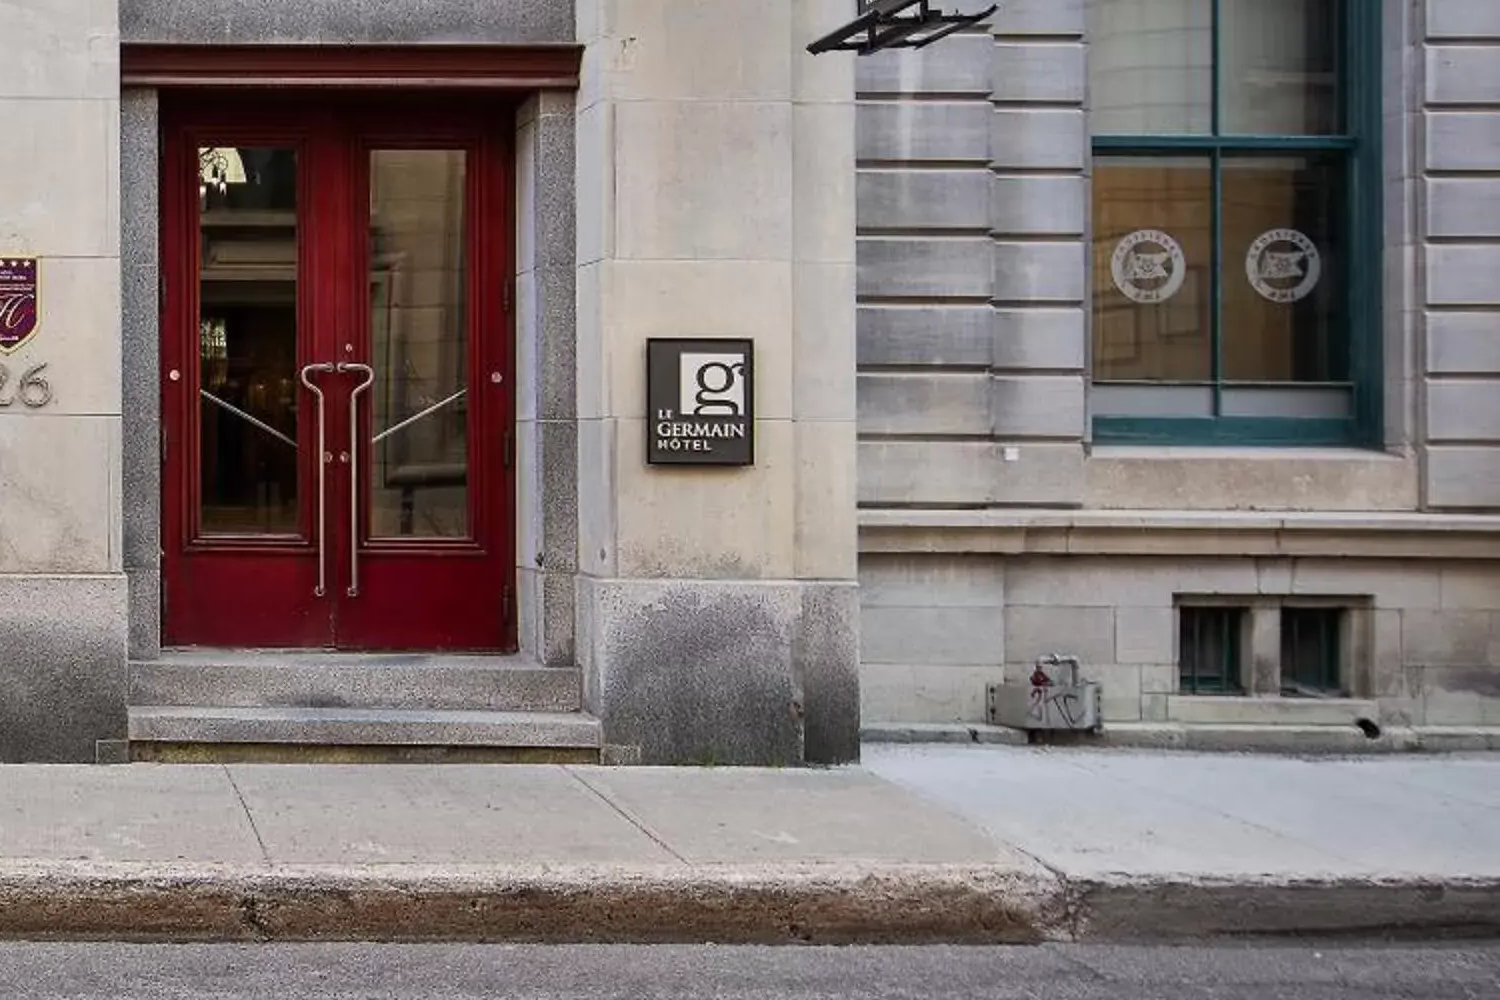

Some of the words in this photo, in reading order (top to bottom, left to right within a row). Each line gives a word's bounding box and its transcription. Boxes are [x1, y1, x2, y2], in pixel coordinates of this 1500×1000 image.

[696, 362, 745, 415] g
[658, 409, 673, 419] LE
[657, 422, 745, 437] GERMAIN
[658, 438, 712, 450] HÔTEL
